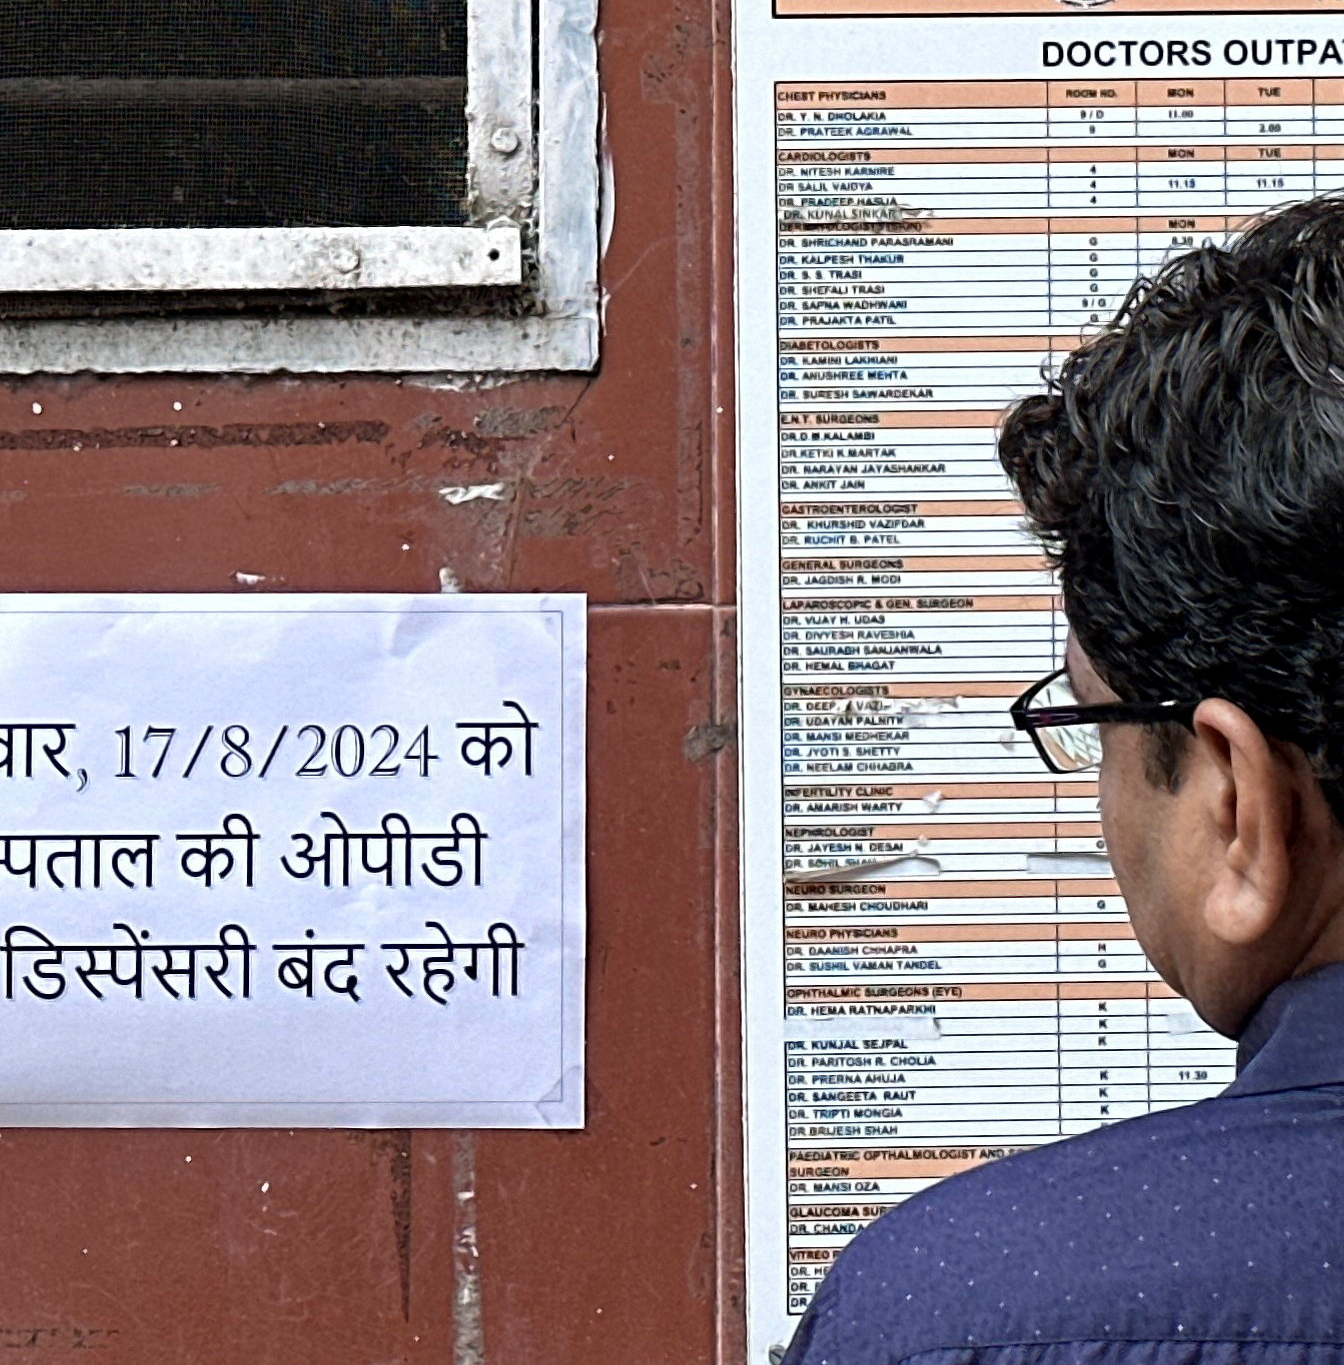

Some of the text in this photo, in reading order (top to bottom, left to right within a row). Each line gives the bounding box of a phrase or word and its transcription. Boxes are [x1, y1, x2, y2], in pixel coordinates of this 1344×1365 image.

[1043, 40, 1211, 66] DOCTORS
[778, 90, 886, 101] CHEST PHYSICIANS
[1167, 88, 1194, 98] MON
[1257, 87, 1281, 97] TUE
[778, 151, 871, 162] CARDIOLOGISTS
[780, 340, 880, 351] DIABETOLOGISTS
[782, 503, 918, 515] GASTROENTEROLOGIST
[782, 559, 904, 570] GENERAL SURGEONS
[917, 598, 974, 608] SURGEON
[783, 686, 889, 696] GYNAECOLOGISTS
[115, 725, 439, 778] 17/8/2024
[456, 701, 539, 776] को
[176, 814, 261, 887] की
[281, 812, 489, 887] ओपीडी
[786, 928, 898, 939] NEURO PHYSICIANS
[272, 929, 365, 1002] बंद
[380, 921, 525, 1006] रहेगी
[786, 988, 862, 999] OPHTHALMIC
[865, 987, 929, 998] SURGEONS
[789, 1150, 860, 1161] PAEDIATRIC
[789, 1166, 849, 1177] SURGEON
